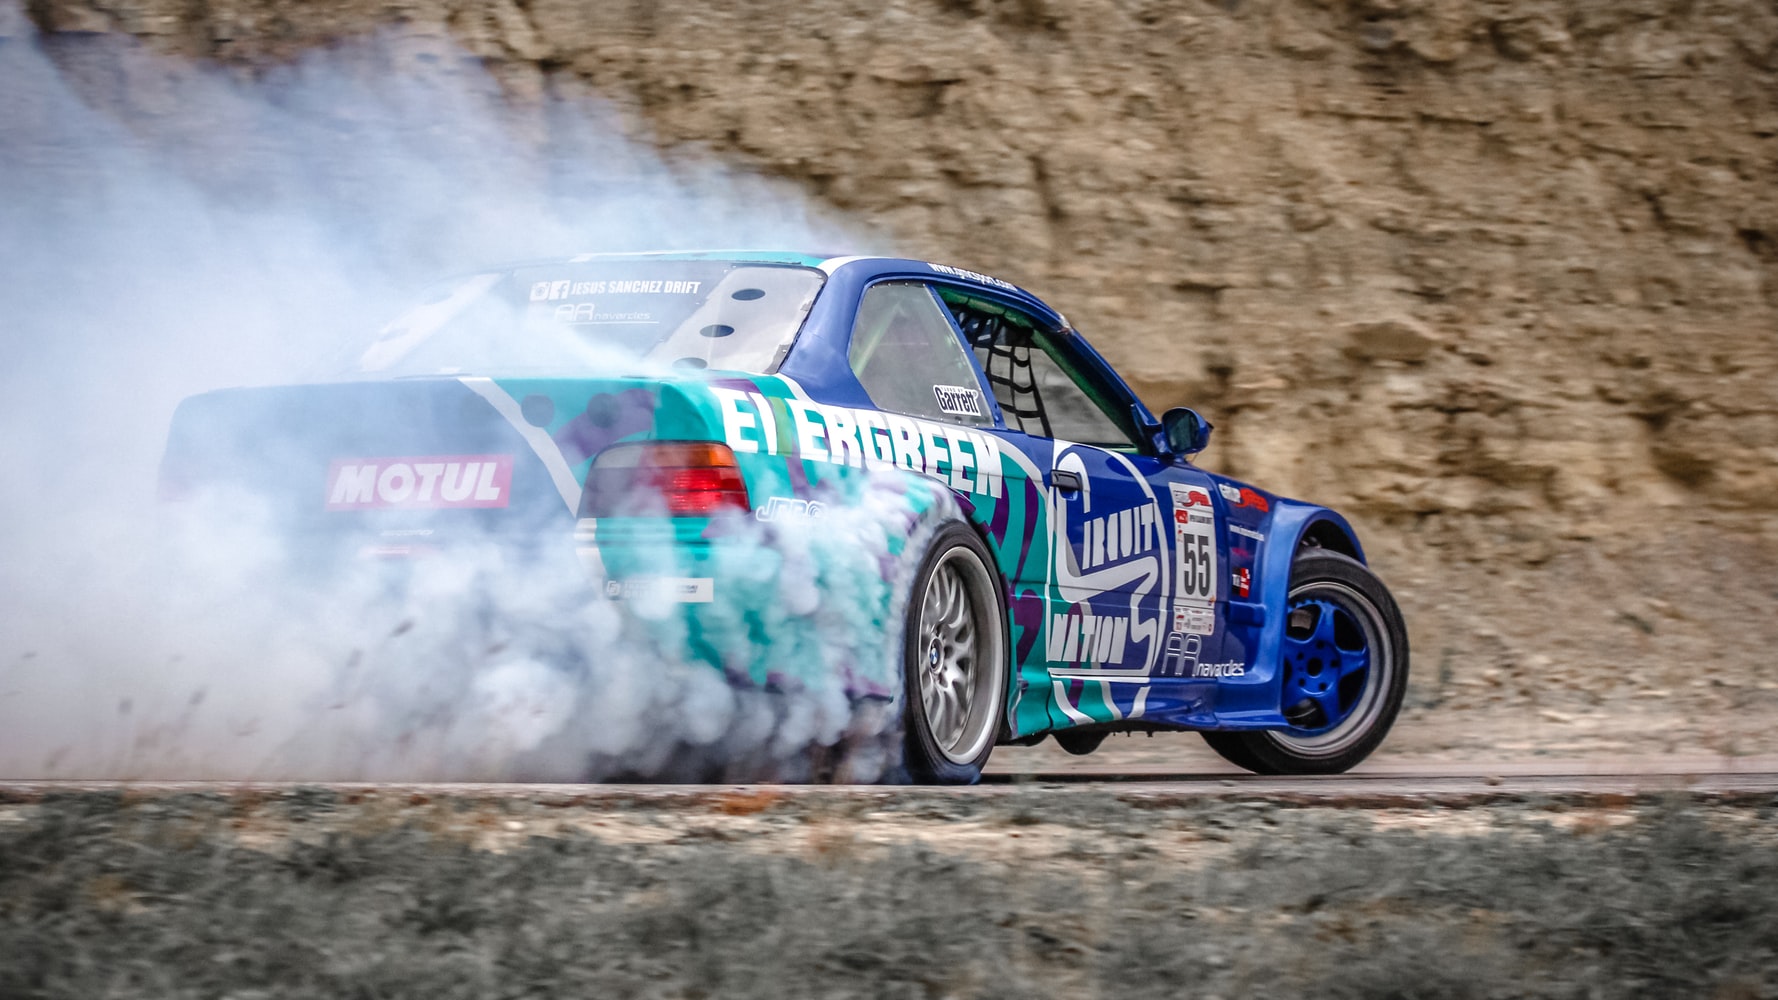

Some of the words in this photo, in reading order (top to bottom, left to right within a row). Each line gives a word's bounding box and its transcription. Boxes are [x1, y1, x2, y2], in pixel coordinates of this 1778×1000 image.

[571, 281, 605, 295] JESUS
[608, 281, 661, 294] SANCHEZ
[664, 281, 701, 294] DRIFT
[934, 386, 979, 413] Garrett
[707, 386, 1003, 499] EVERGREEN
[330, 462, 501, 504] MOTUL
[1184, 533, 1210, 597] 55
